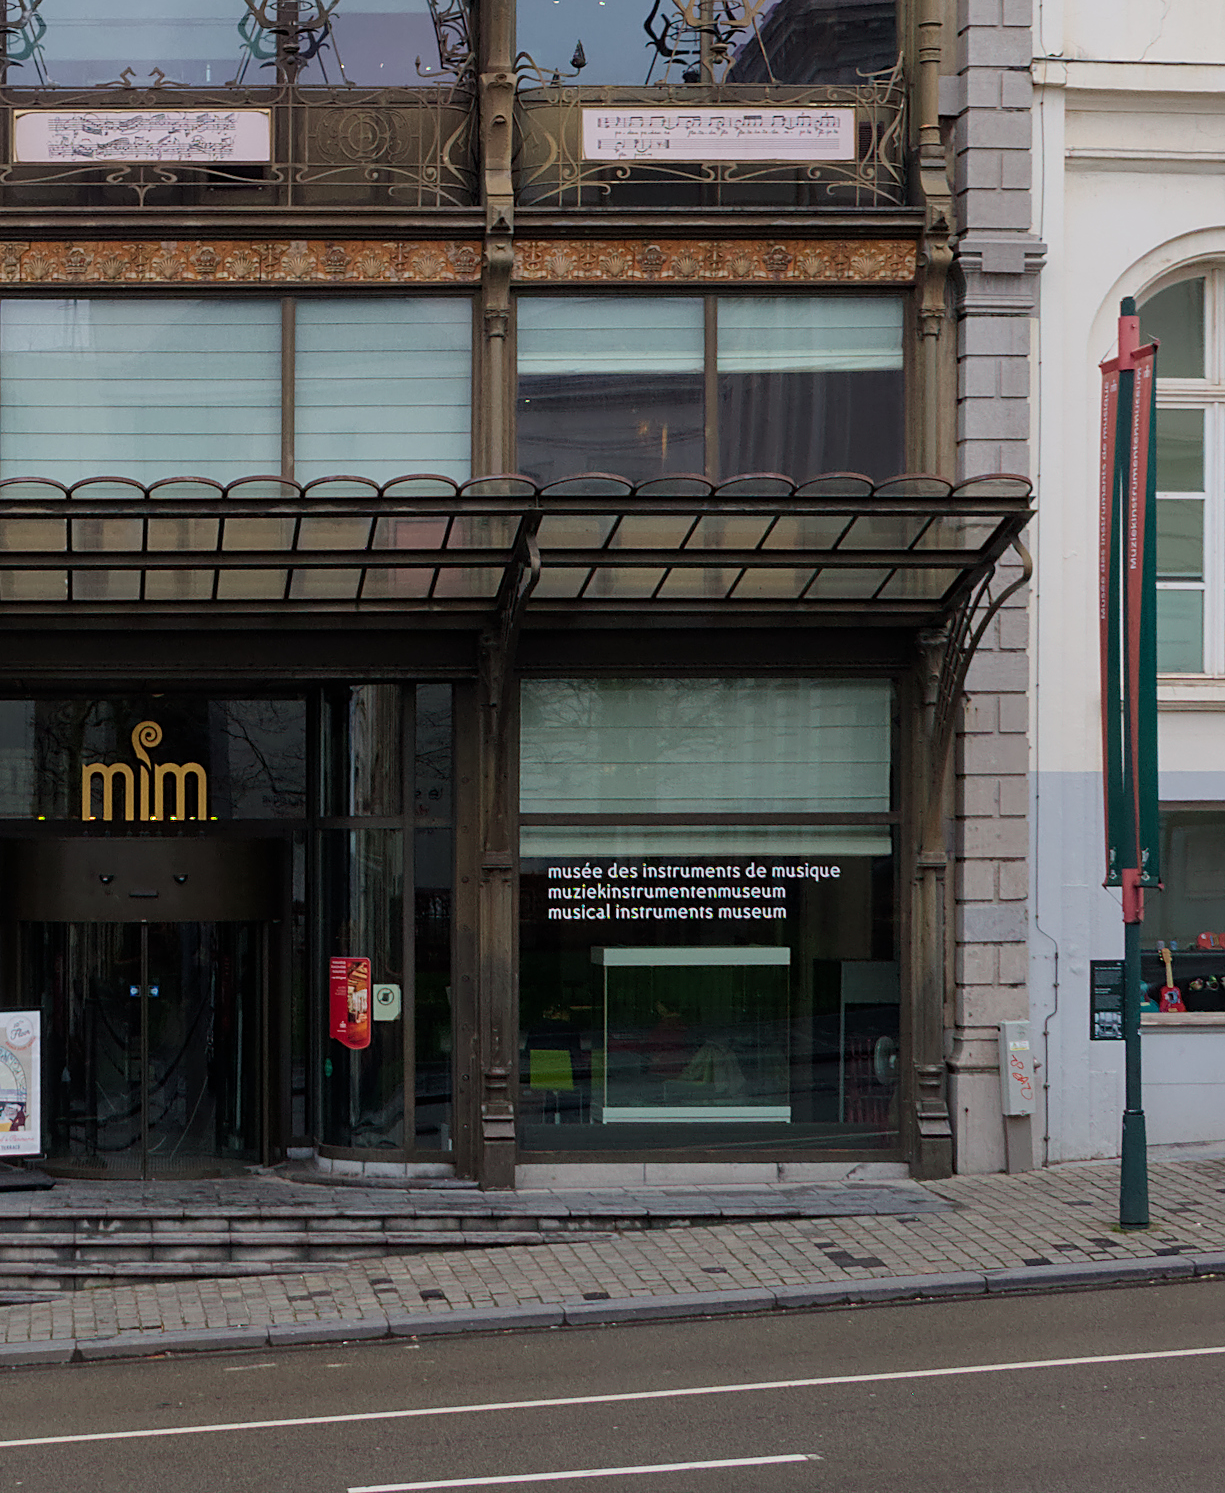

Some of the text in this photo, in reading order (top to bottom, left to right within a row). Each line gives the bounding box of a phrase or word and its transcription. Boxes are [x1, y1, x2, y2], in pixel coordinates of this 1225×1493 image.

[1102, 443, 1107, 460] de
[1130, 367, 1142, 570] Muziekinstrumentenmuseum
[81, 721, 208, 821] mim
[548, 862, 841, 882] musée des instruments de musique
[548, 882, 786, 900] muziekinstrumentenmuseum
[548, 903, 787, 920] musical instruments museum
